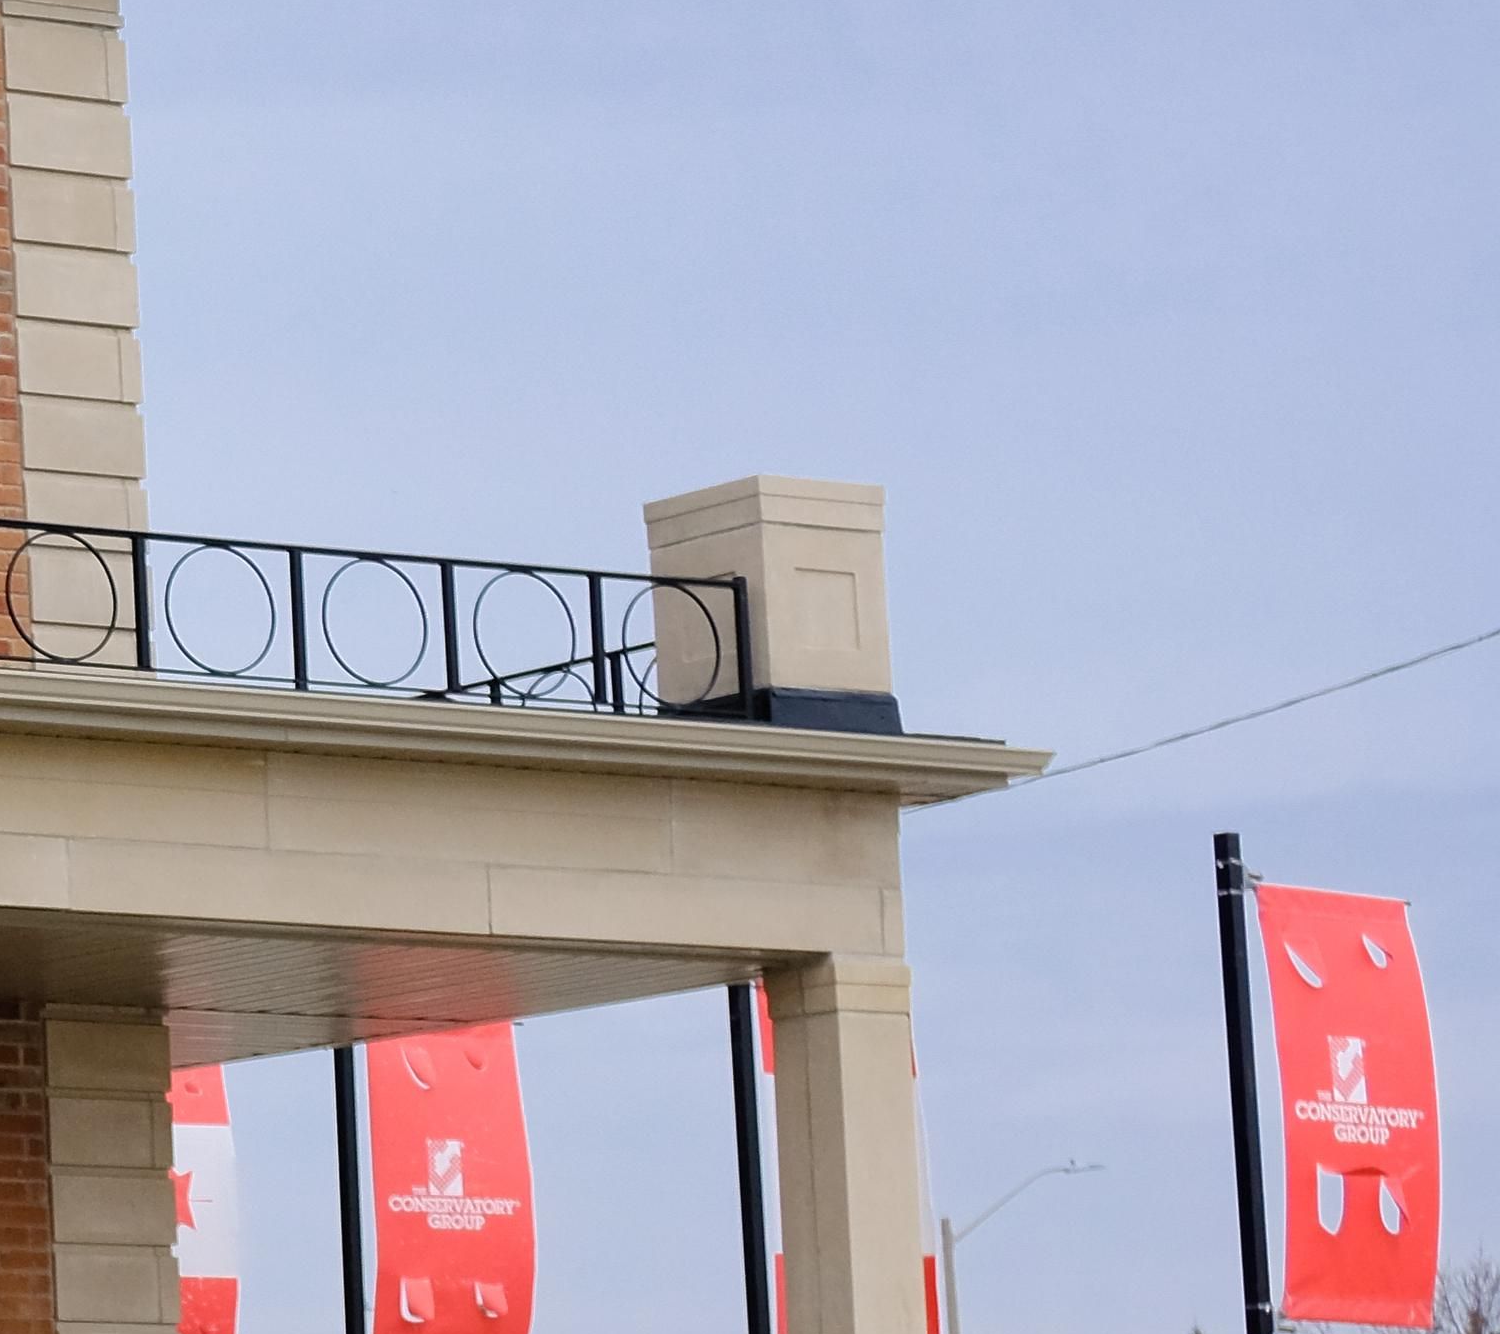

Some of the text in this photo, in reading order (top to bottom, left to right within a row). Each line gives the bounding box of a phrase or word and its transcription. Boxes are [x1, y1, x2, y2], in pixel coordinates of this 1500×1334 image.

[1295, 1099, 1419, 1128] CONSERVATORY
[1334, 1124, 1390, 1145] GROUP
[388, 1195, 516, 1215] CONSERVATORY
[427, 1214, 485, 1231] GROUP
